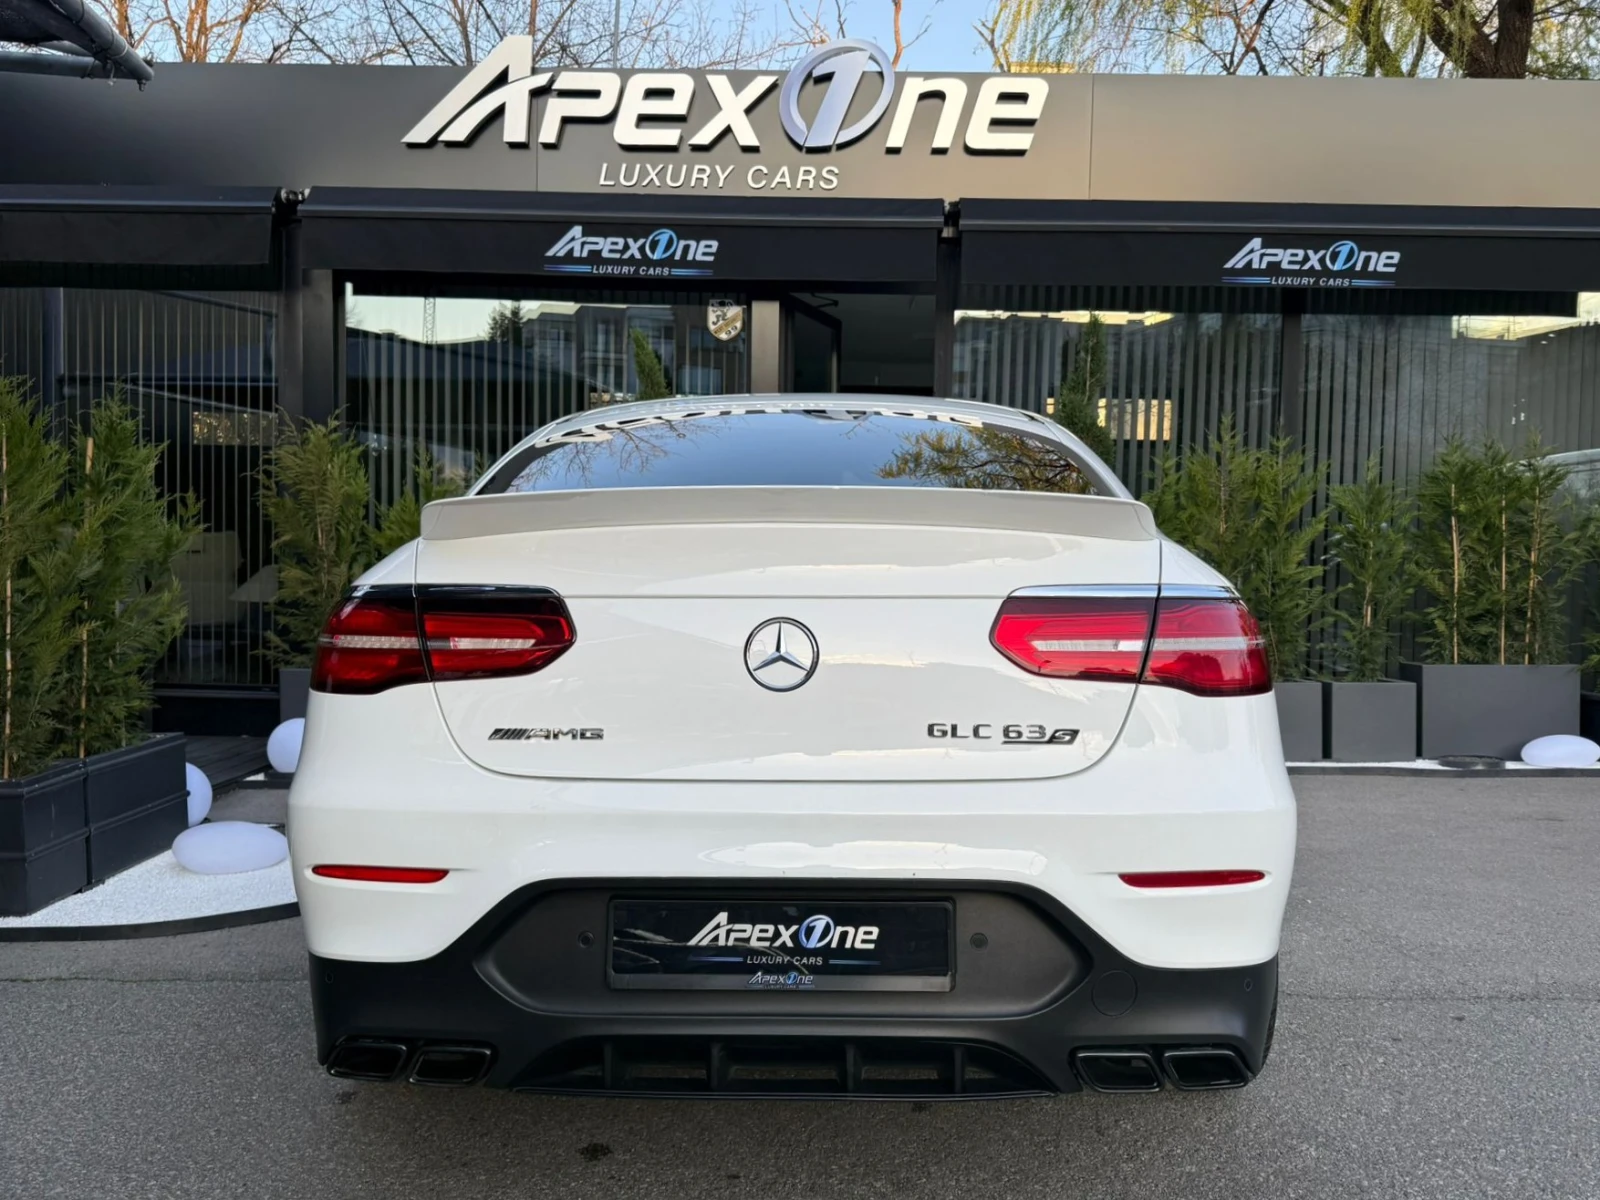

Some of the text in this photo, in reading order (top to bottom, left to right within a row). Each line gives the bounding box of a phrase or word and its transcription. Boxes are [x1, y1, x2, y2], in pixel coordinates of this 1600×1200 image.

[599, 163, 840, 190] LUXURY CARS
[592, 265, 670, 276] LUXURY CARS
[1271, 276, 1350, 287] LUXURY CARS
[523, 727, 604, 741] AMG
[927, 722, 992, 739] GLC
[746, 955, 823, 966] LUXURY CARS
